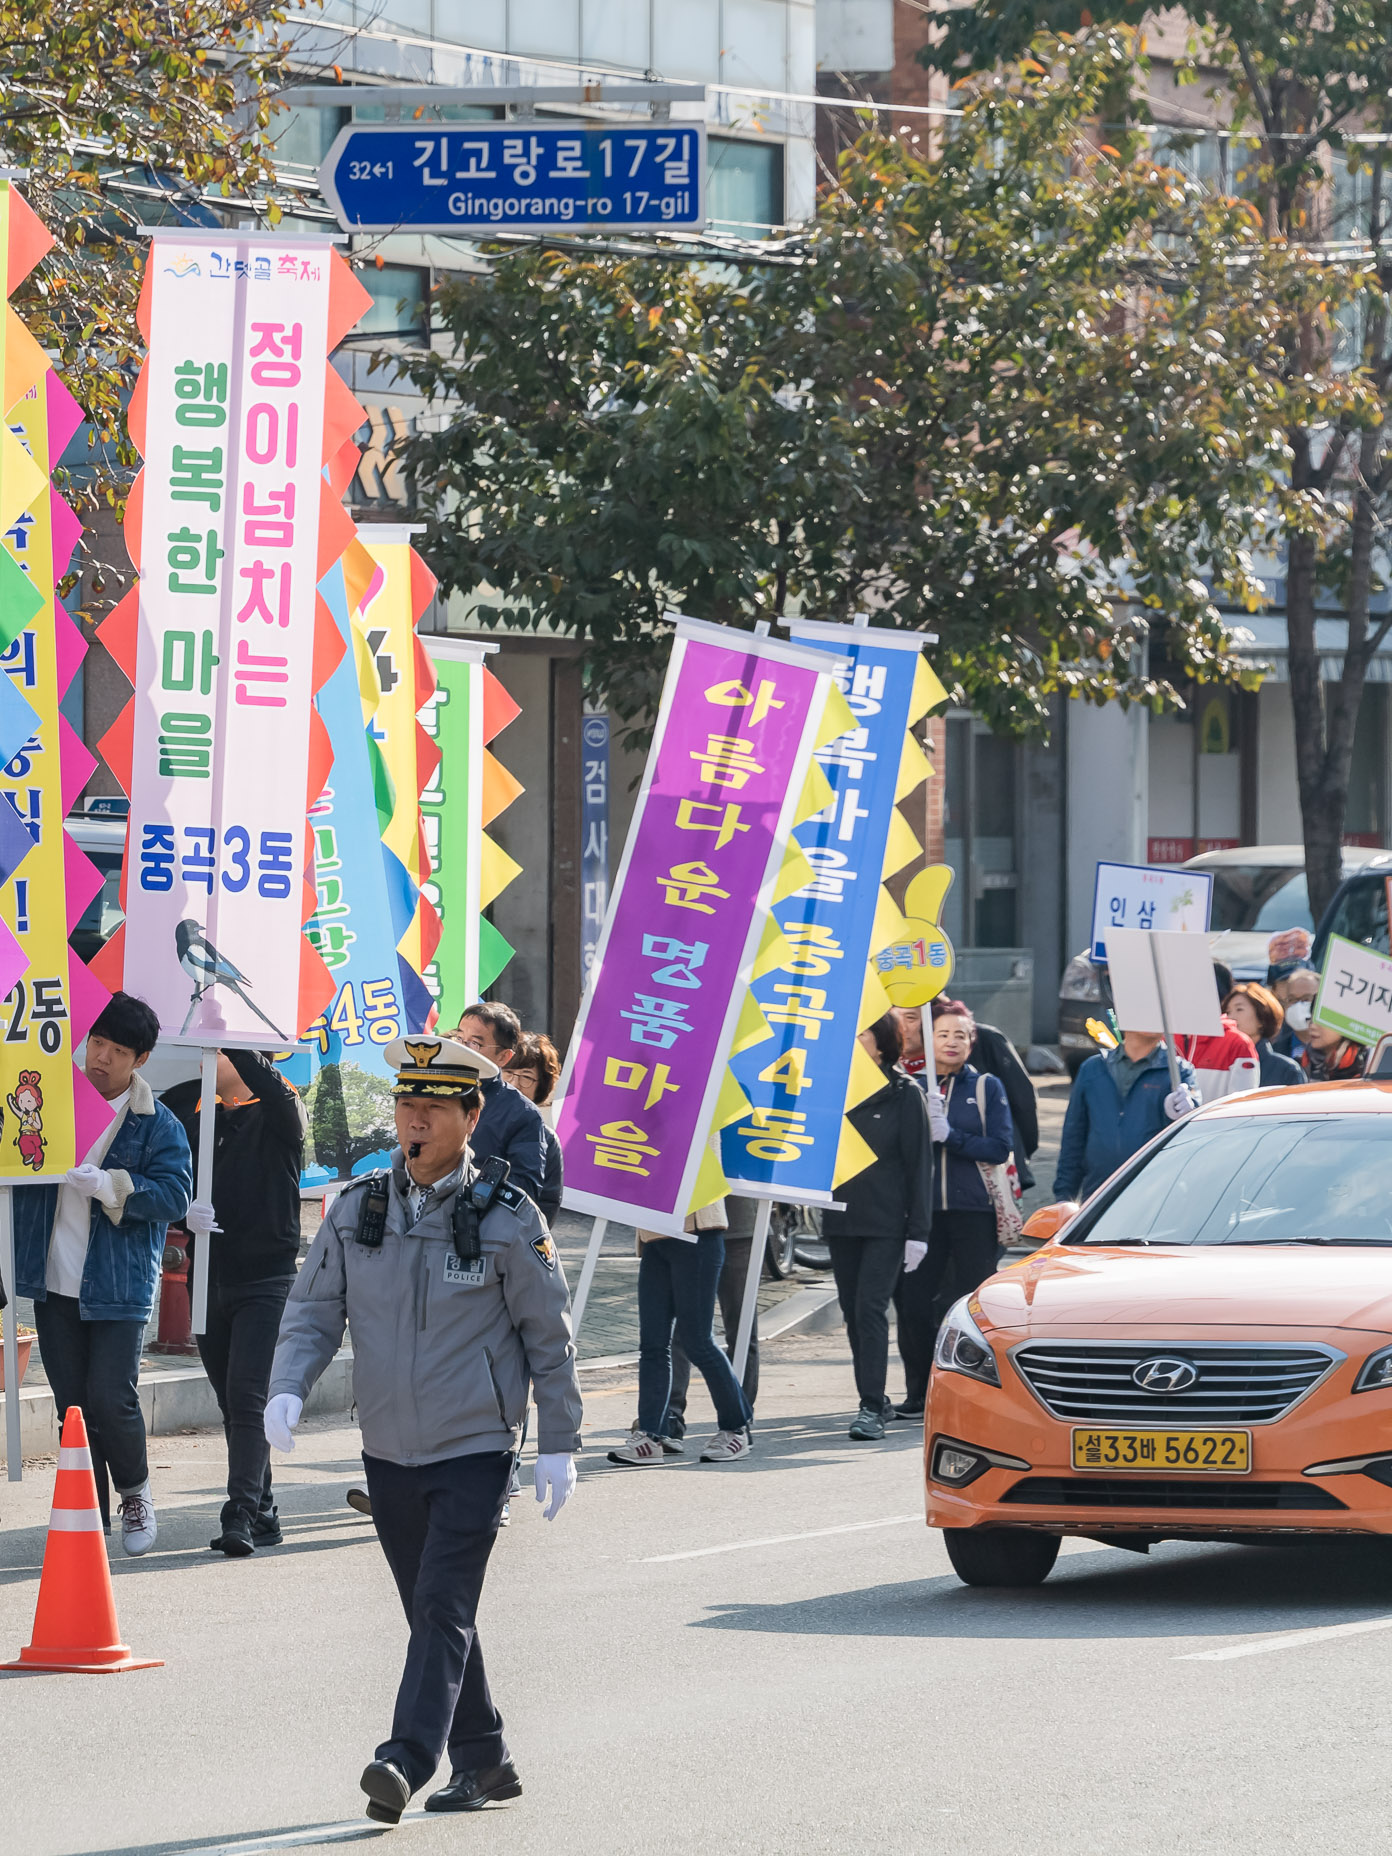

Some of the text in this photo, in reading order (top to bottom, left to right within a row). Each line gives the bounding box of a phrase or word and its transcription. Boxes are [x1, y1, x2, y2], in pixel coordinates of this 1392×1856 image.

[412, 134, 691, 187] 긴고랑로17길
[447, 191, 690, 220] Gingorang-ro 17-gil
[139, 823, 294, 900] 중곡3동
[447, 1272, 481, 1282] POLICE
[1164, 1436, 1237, 1465] 5622
